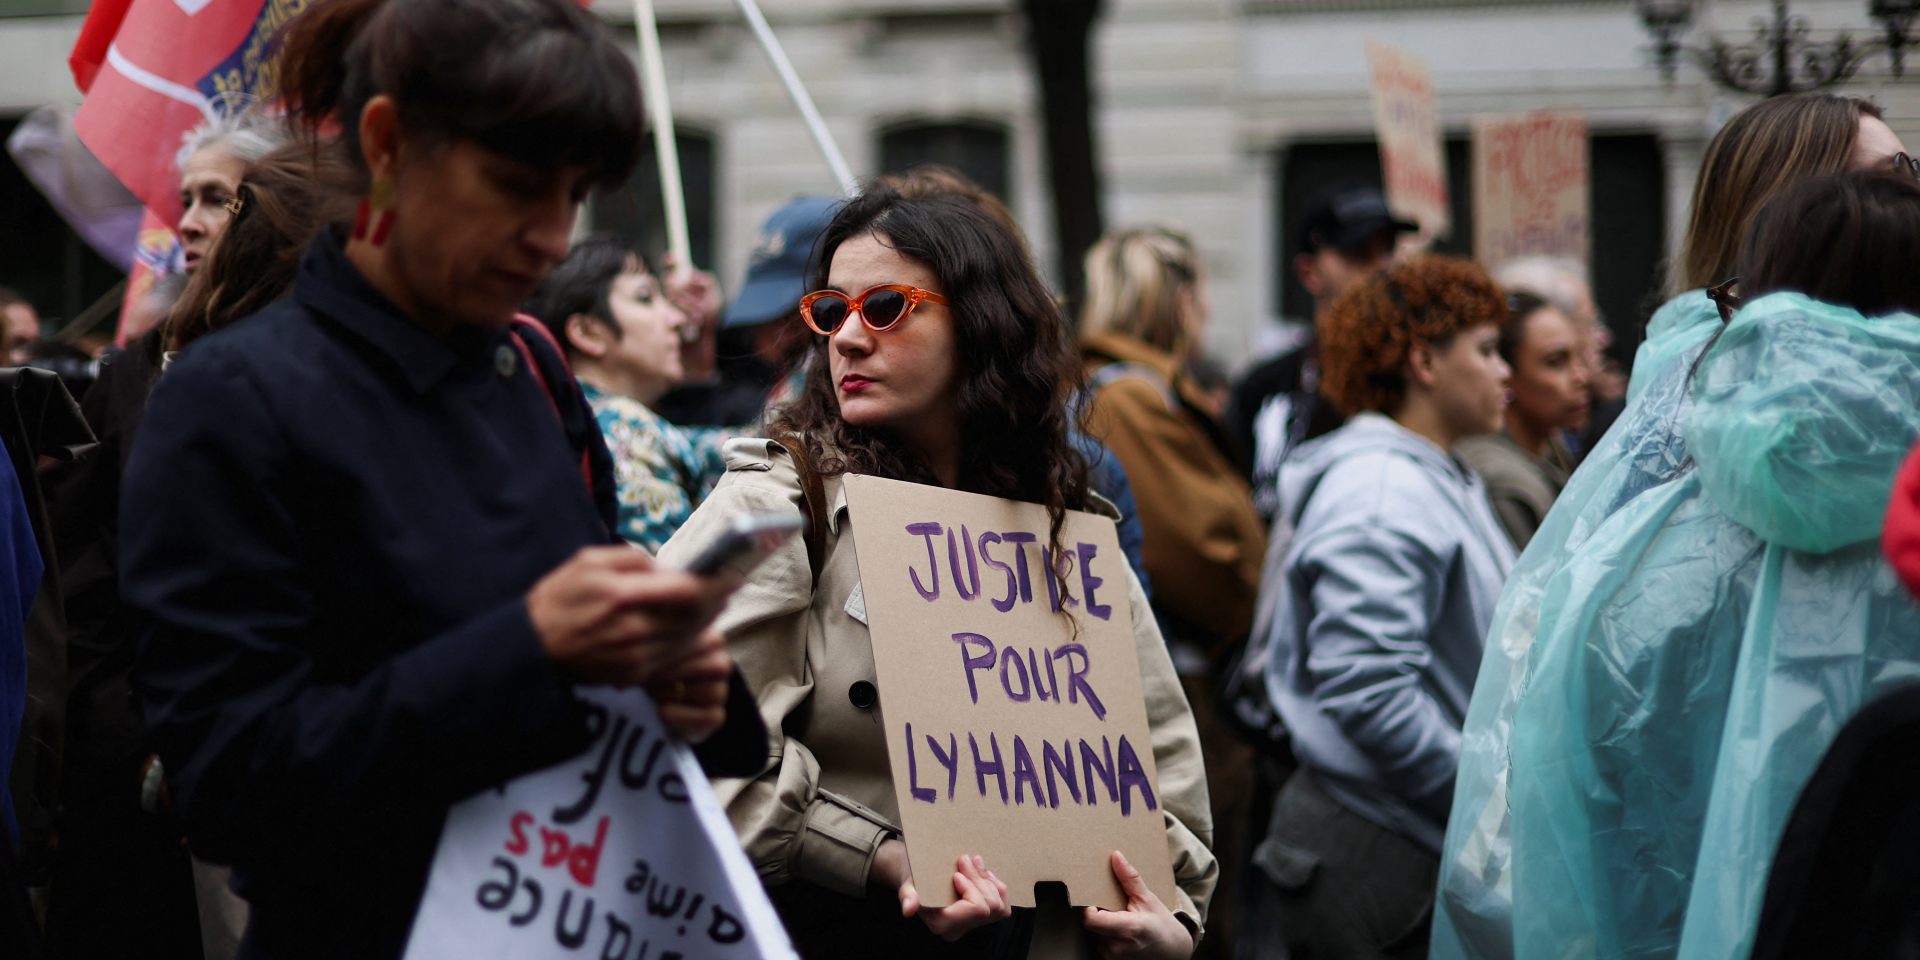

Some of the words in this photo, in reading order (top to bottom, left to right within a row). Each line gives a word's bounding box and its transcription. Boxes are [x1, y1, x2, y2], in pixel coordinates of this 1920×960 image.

[905, 522, 1112, 620] JUSTICE
[951, 632, 1106, 722] POUR
[905, 722, 1157, 816] LYHANNA
[504, 811, 610, 887] pas
[625, 858, 745, 944] aime
